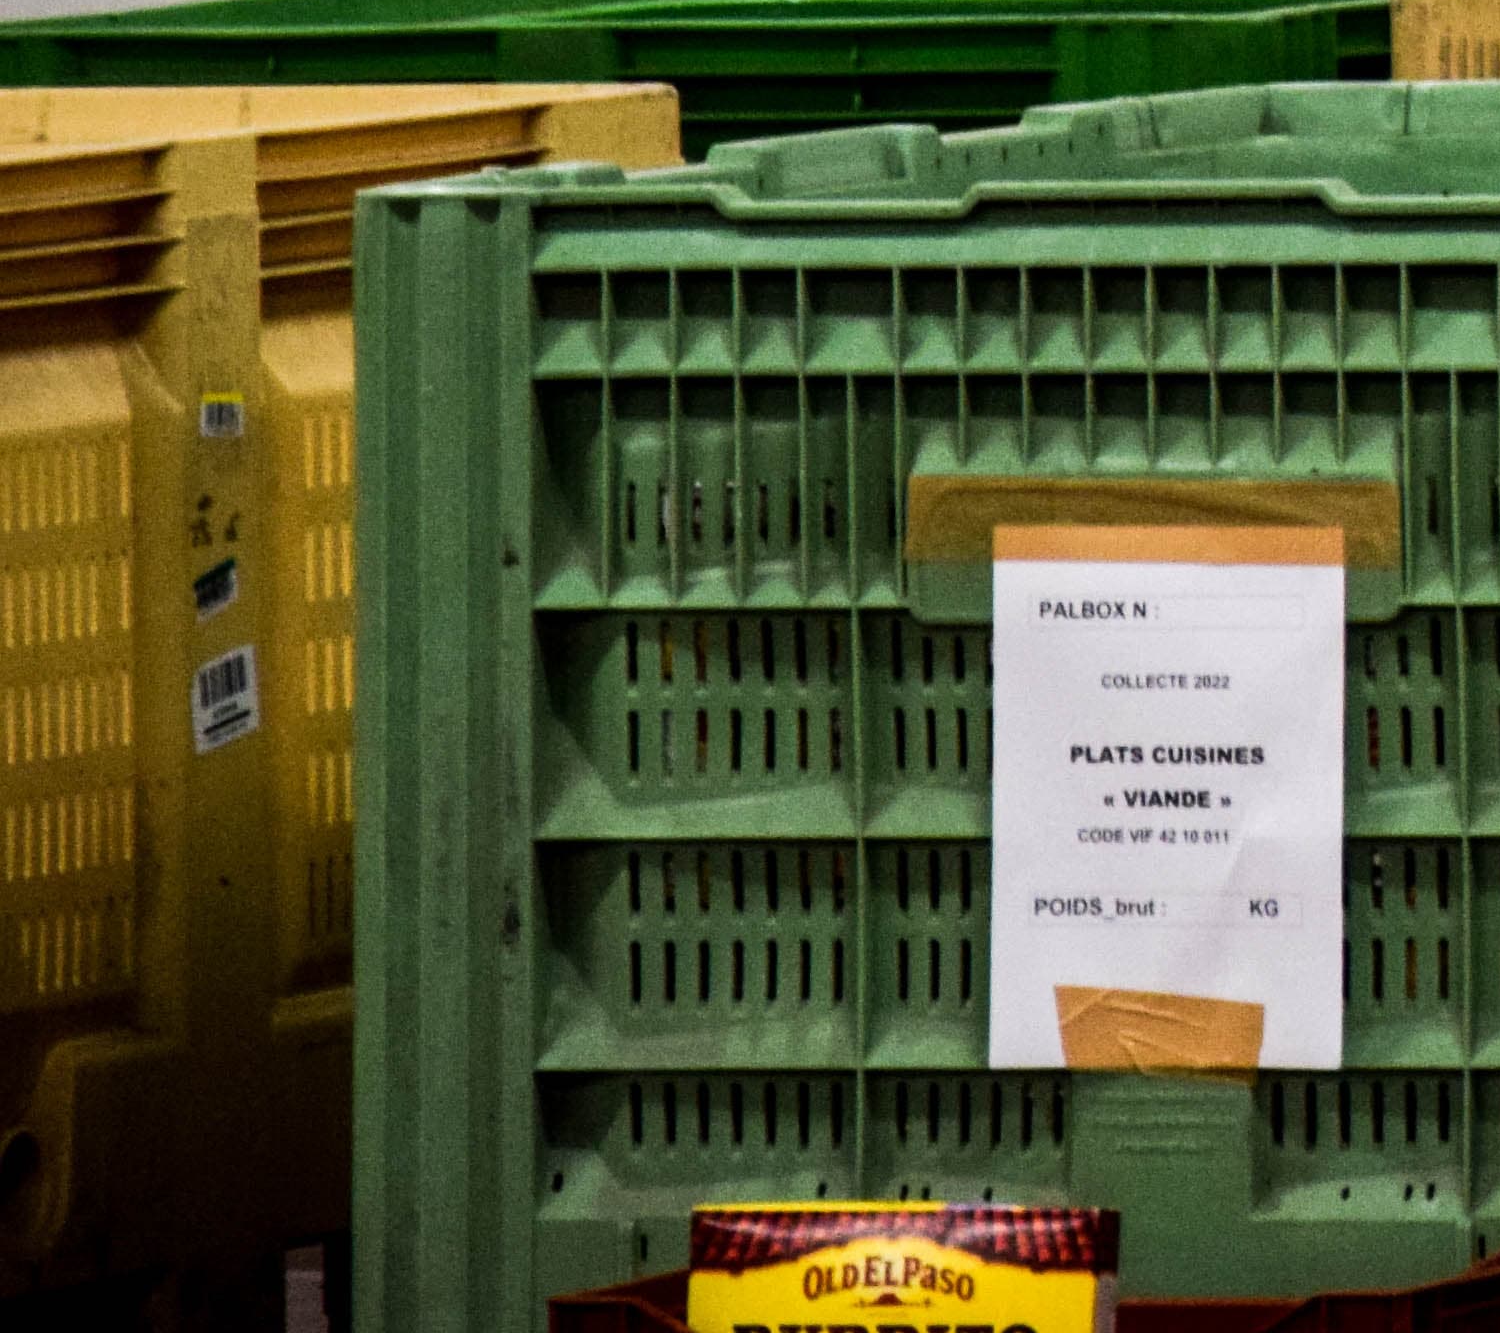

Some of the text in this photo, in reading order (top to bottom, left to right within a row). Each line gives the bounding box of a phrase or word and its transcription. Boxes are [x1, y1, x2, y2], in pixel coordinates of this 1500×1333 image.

[1039, 600, 1127, 620] PALBOX
[1132, 600, 1148, 620] N
[1100, 673, 1231, 691] COLLECTE 2022
[1070, 745, 1266, 766] PLATS CUISINES
[1122, 789, 1212, 809] VIANDE
[1077, 827, 1124, 845] CODE
[1130, 827, 1154, 844] VIF
[1159, 828, 1177, 845] 42
[1033, 897, 1155, 924] POIDS_brut
[1249, 898, 1279, 919] KG
